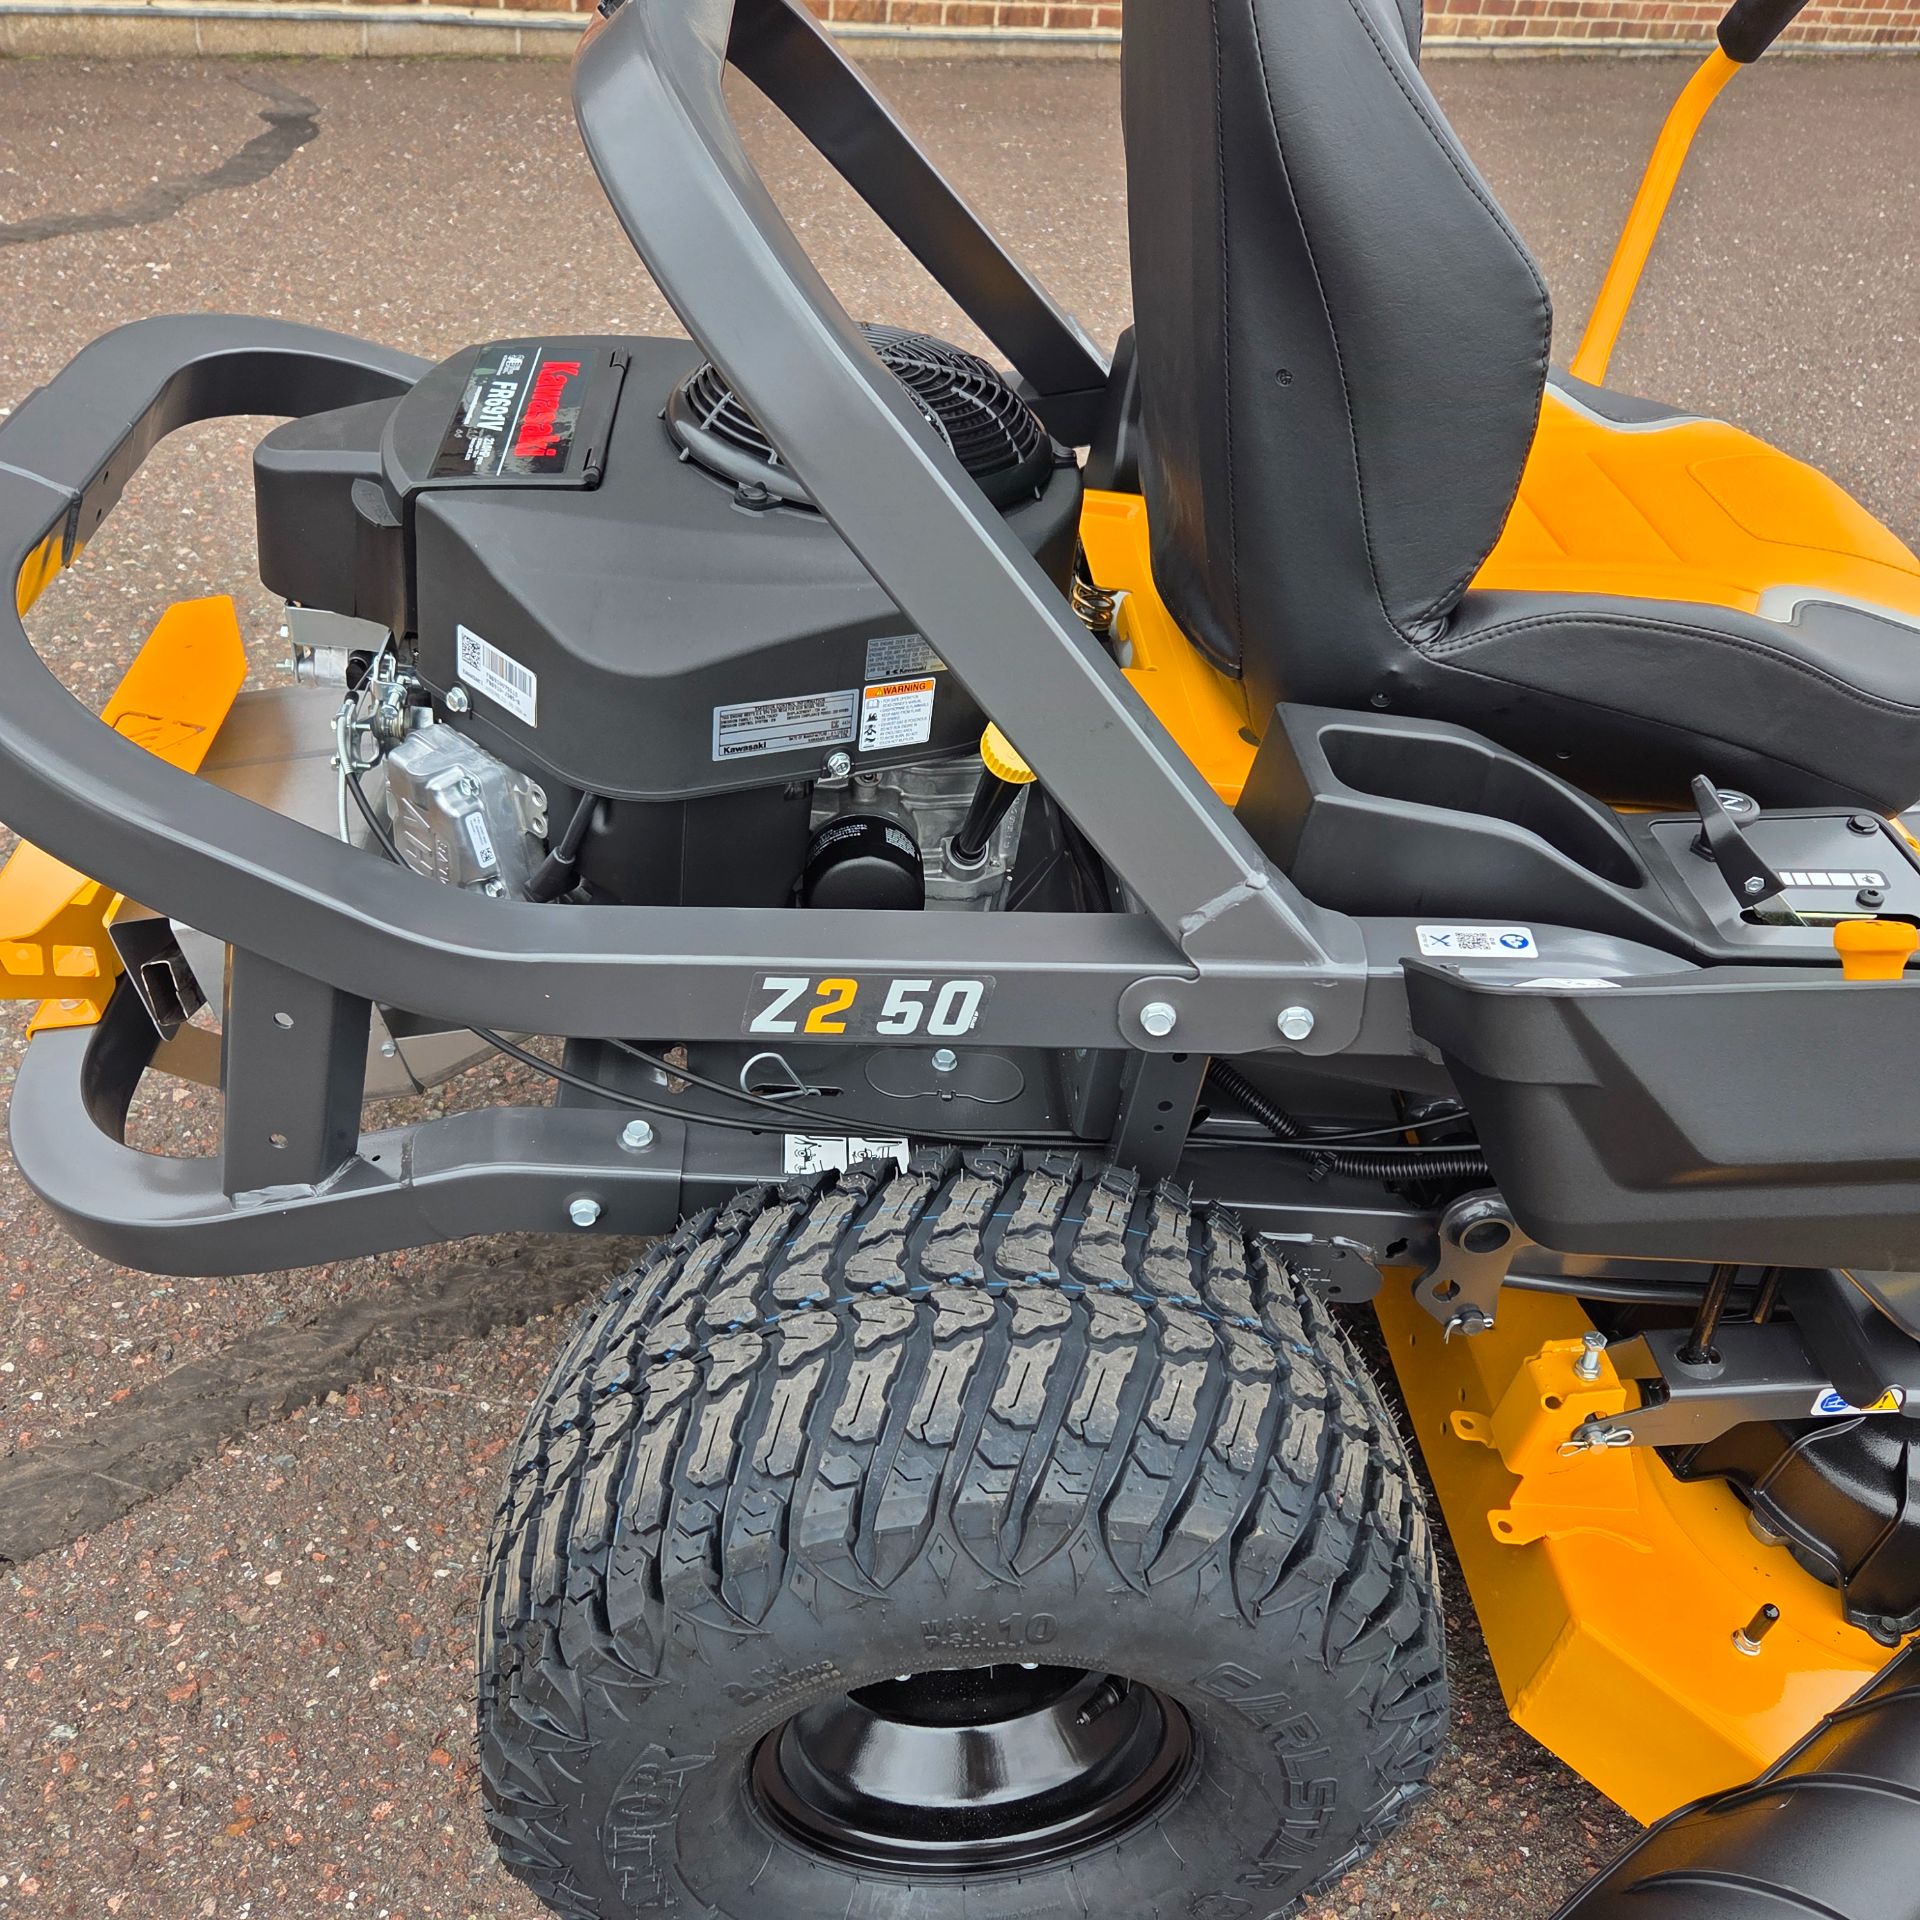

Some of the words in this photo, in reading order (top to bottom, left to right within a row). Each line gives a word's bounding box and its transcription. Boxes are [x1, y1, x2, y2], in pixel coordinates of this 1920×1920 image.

[477, 381, 518, 432] FR691V
[513, 361, 581, 457] Kawasaki
[883, 682, 926, 695] WARNING
[723, 742, 767, 755] Kawasaki
[750, 977, 858, 1034] Z2
[876, 979, 984, 1036] 50
[999, 1612, 1058, 1645] 10
